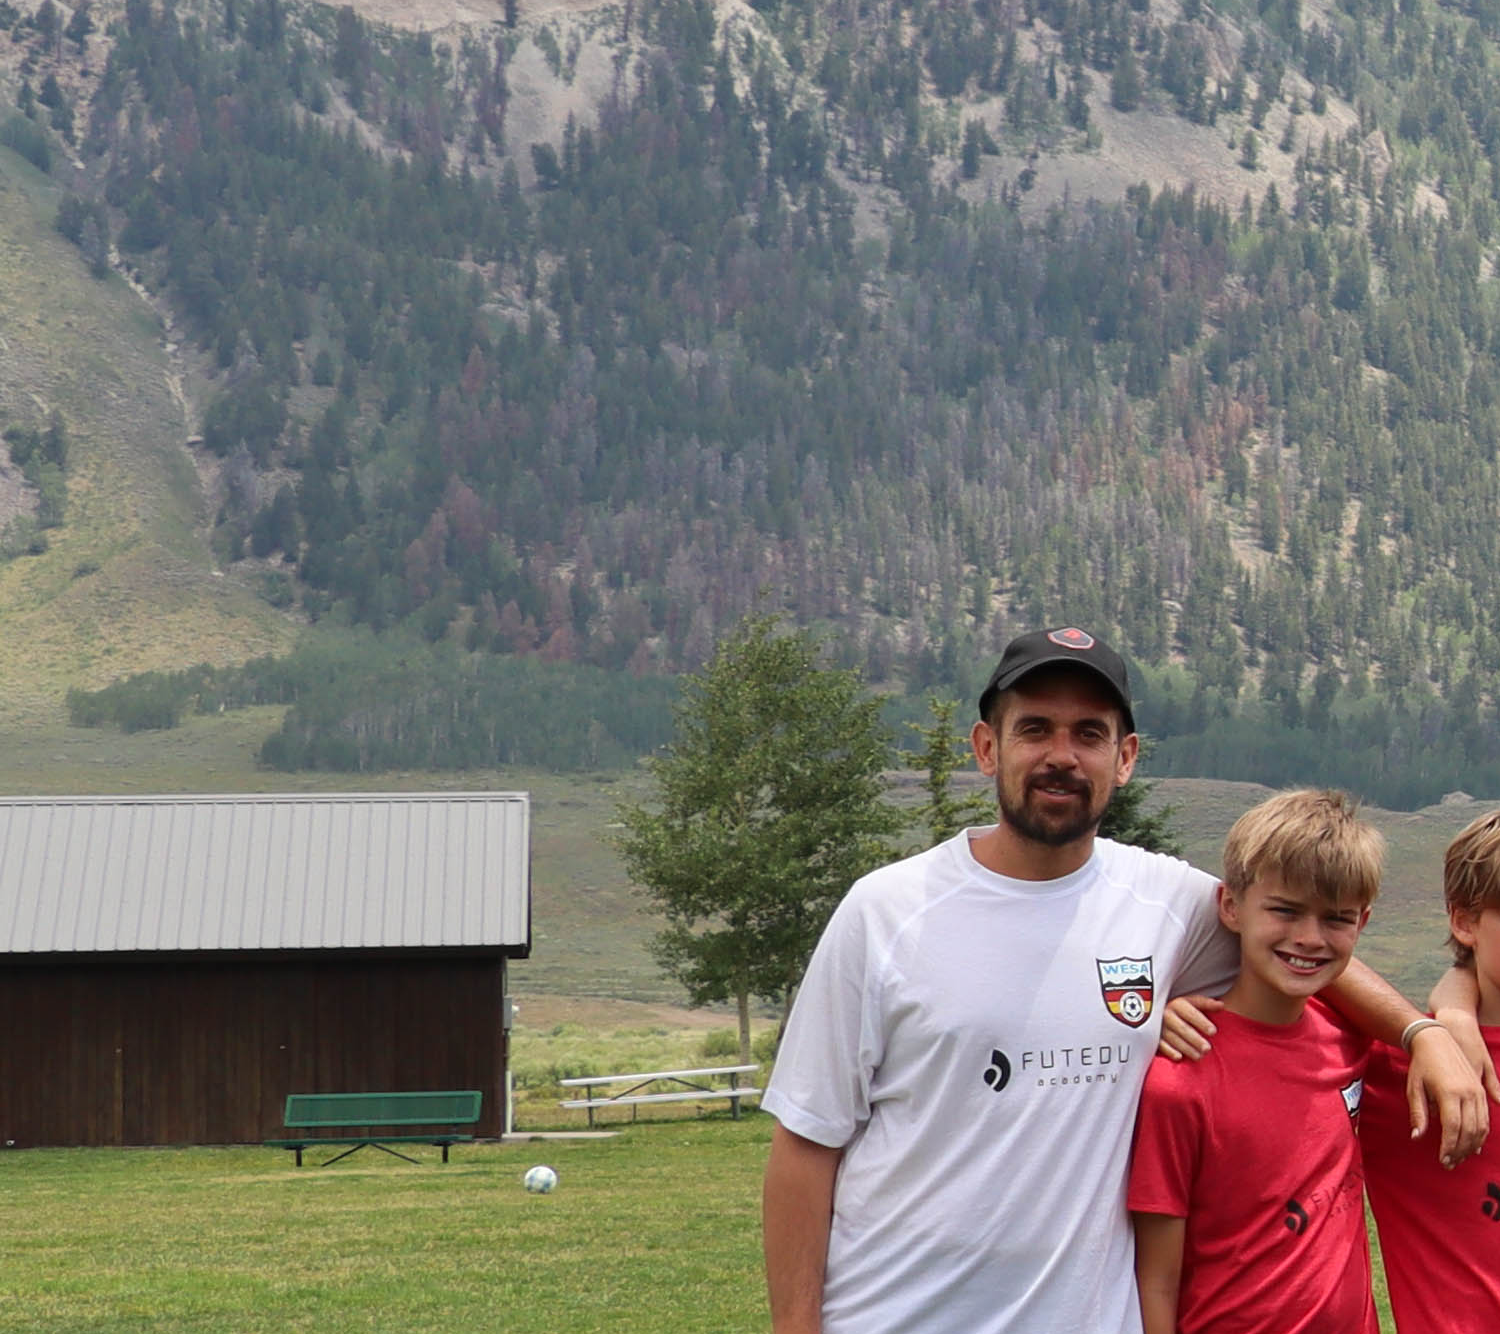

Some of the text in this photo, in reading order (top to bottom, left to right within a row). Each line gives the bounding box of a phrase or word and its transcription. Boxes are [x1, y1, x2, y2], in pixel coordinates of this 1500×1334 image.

[1102, 963, 1149, 975] WESA
[1021, 1045, 1131, 1071] FUTEDU
[1037, 1073, 1119, 1086] academy
